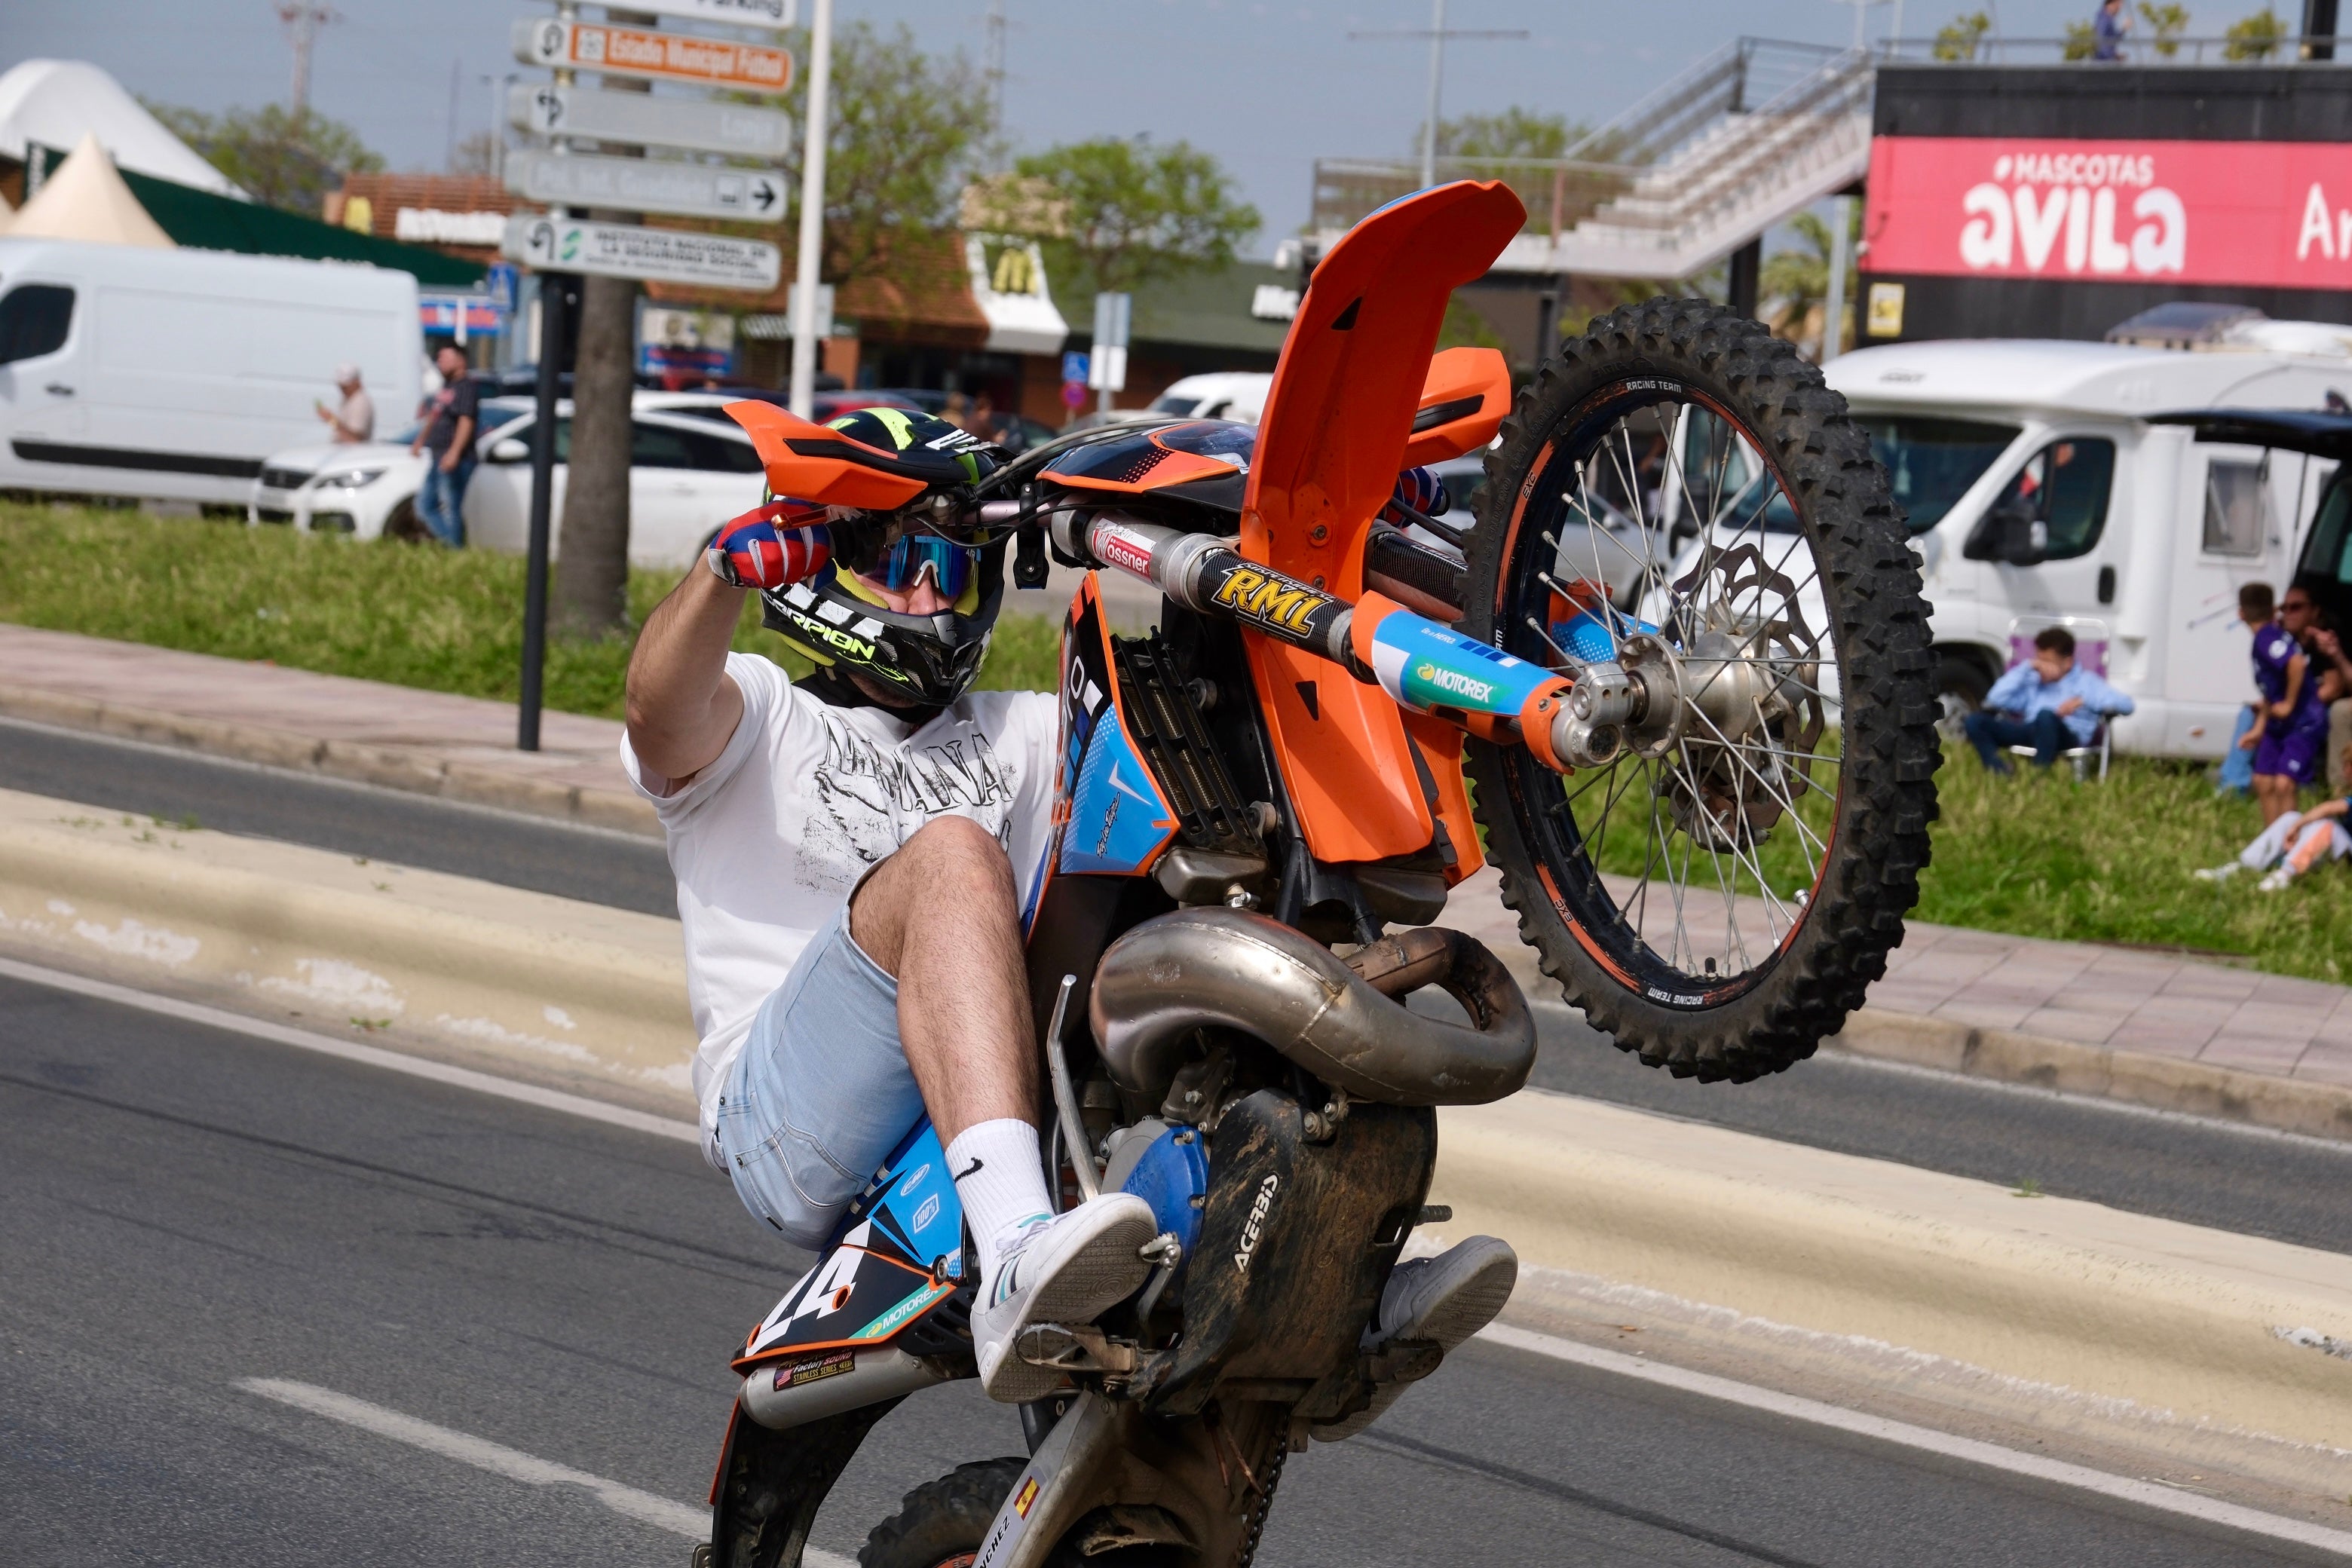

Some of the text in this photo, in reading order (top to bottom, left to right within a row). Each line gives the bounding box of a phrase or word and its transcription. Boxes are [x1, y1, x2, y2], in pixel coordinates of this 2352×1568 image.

[2014, 152, 2154, 187] MASCOTAS
[1523, 471, 1536, 499] EXC
[1433, 668, 1493, 703] MOTOREX
[1554, 899, 1573, 923] EXC
[917, 1199, 936, 1227] 100%
[820, 1364, 837, 1375] SERIES
[823, 1352, 853, 1365] SOUND
